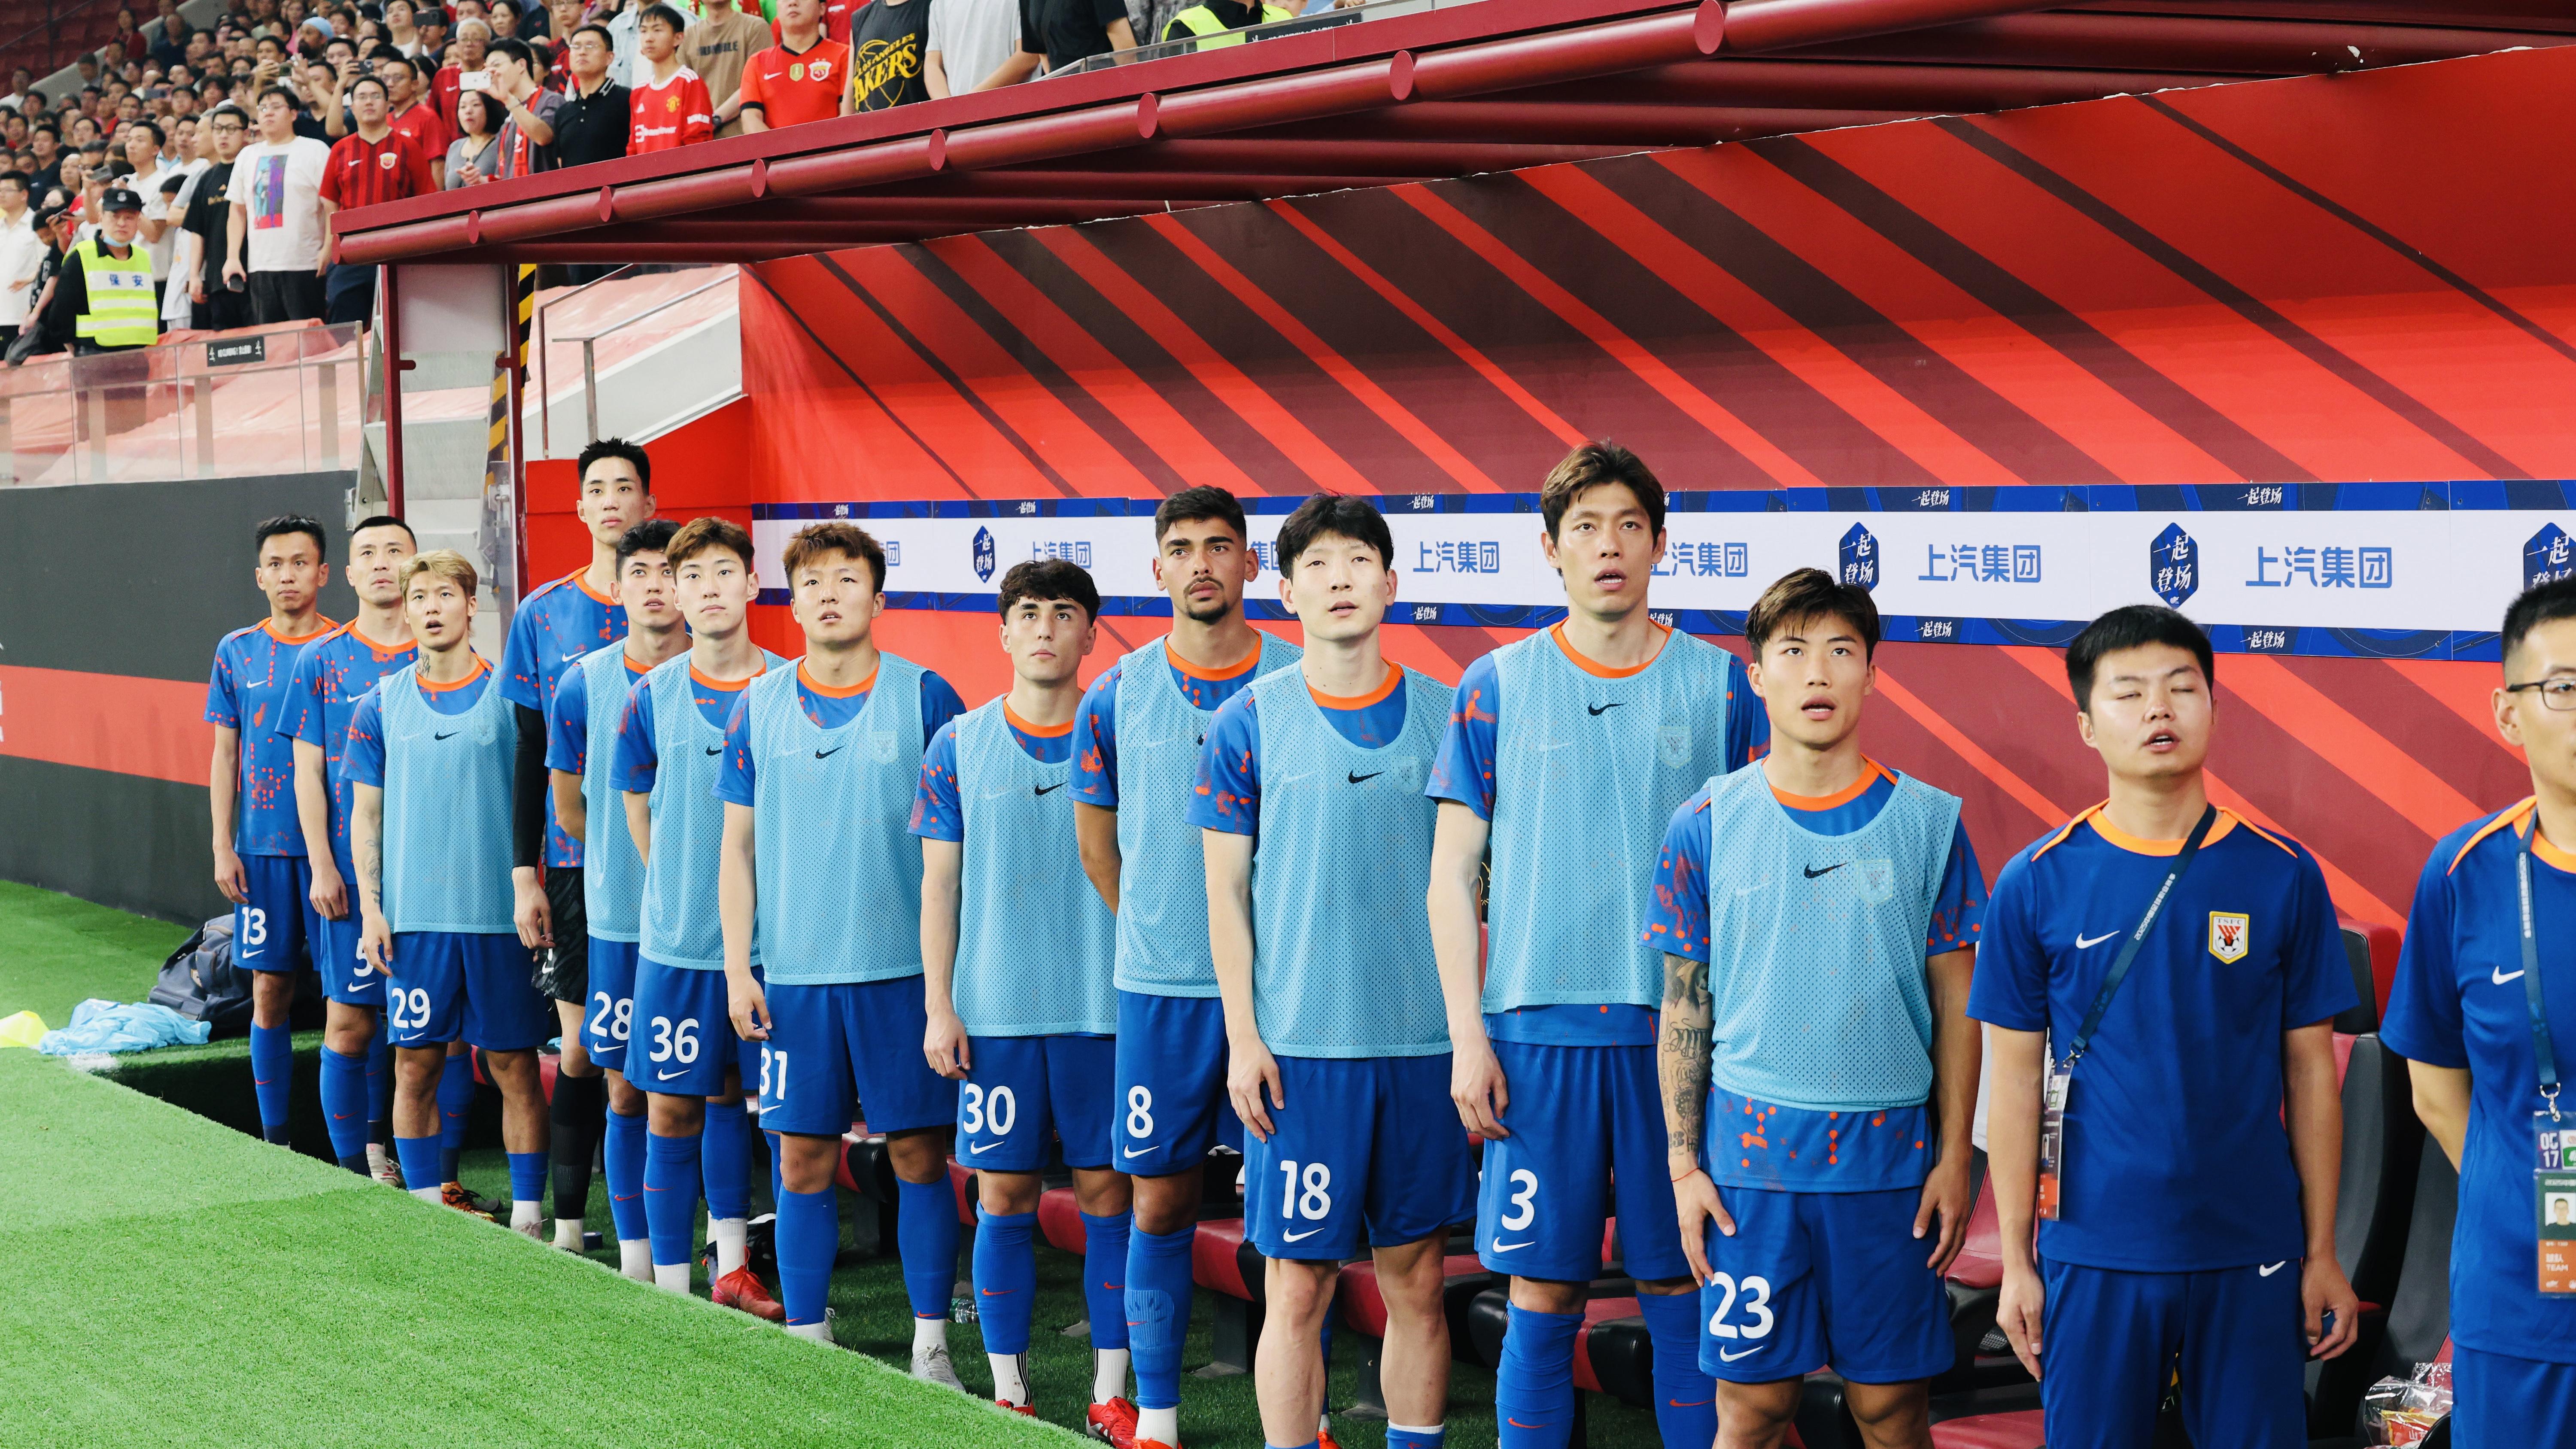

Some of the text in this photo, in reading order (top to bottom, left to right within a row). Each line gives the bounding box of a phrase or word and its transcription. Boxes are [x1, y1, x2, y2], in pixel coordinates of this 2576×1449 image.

[854, 43, 923, 110] AKERS
[109, 273, 143, 287] 保安
[1407, 495, 1434, 510] 一起登场
[1911, 489, 1949, 507] 一起登场
[2237, 486, 2282, 506] 一起登场
[974, 534, 991, 551] 一起
[1413, 541, 1499, 573] 上汽集团
[1841, 532, 1871, 559] 一起
[2153, 534, 2189, 563] 一起
[2526, 535, 2570, 567] 一起
[976, 553, 993, 572] 登场
[1844, 559, 1874, 584] 登场
[1918, 544, 2041, 583] 上汽集团
[2157, 563, 2192, 594] 登场
[2245, 547, 2392, 589] 上汽集团
[1410, 606, 1437, 621] 一起登场
[1914, 621, 1952, 638] 一起登场
[2239, 630, 2285, 650] 一起登场
[242, 907, 267, 945] 13
[354, 938, 374, 977] 5
[392, 987, 431, 1028] 29
[589, 991, 633, 1040] 28
[650, 1016, 699, 1063] 36
[759, 1048, 787, 1100] 31
[963, 1083, 1015, 1135] 30
[1127, 1085, 1153, 1138] 8
[2543, 1150, 2559, 1168] 17
[1280, 1160, 1331, 1220] 18
[1501, 1169, 1538, 1231] 3
[2546, 1263, 2569, 1272] TEAM
[1709, 1271, 1774, 1339] 23
